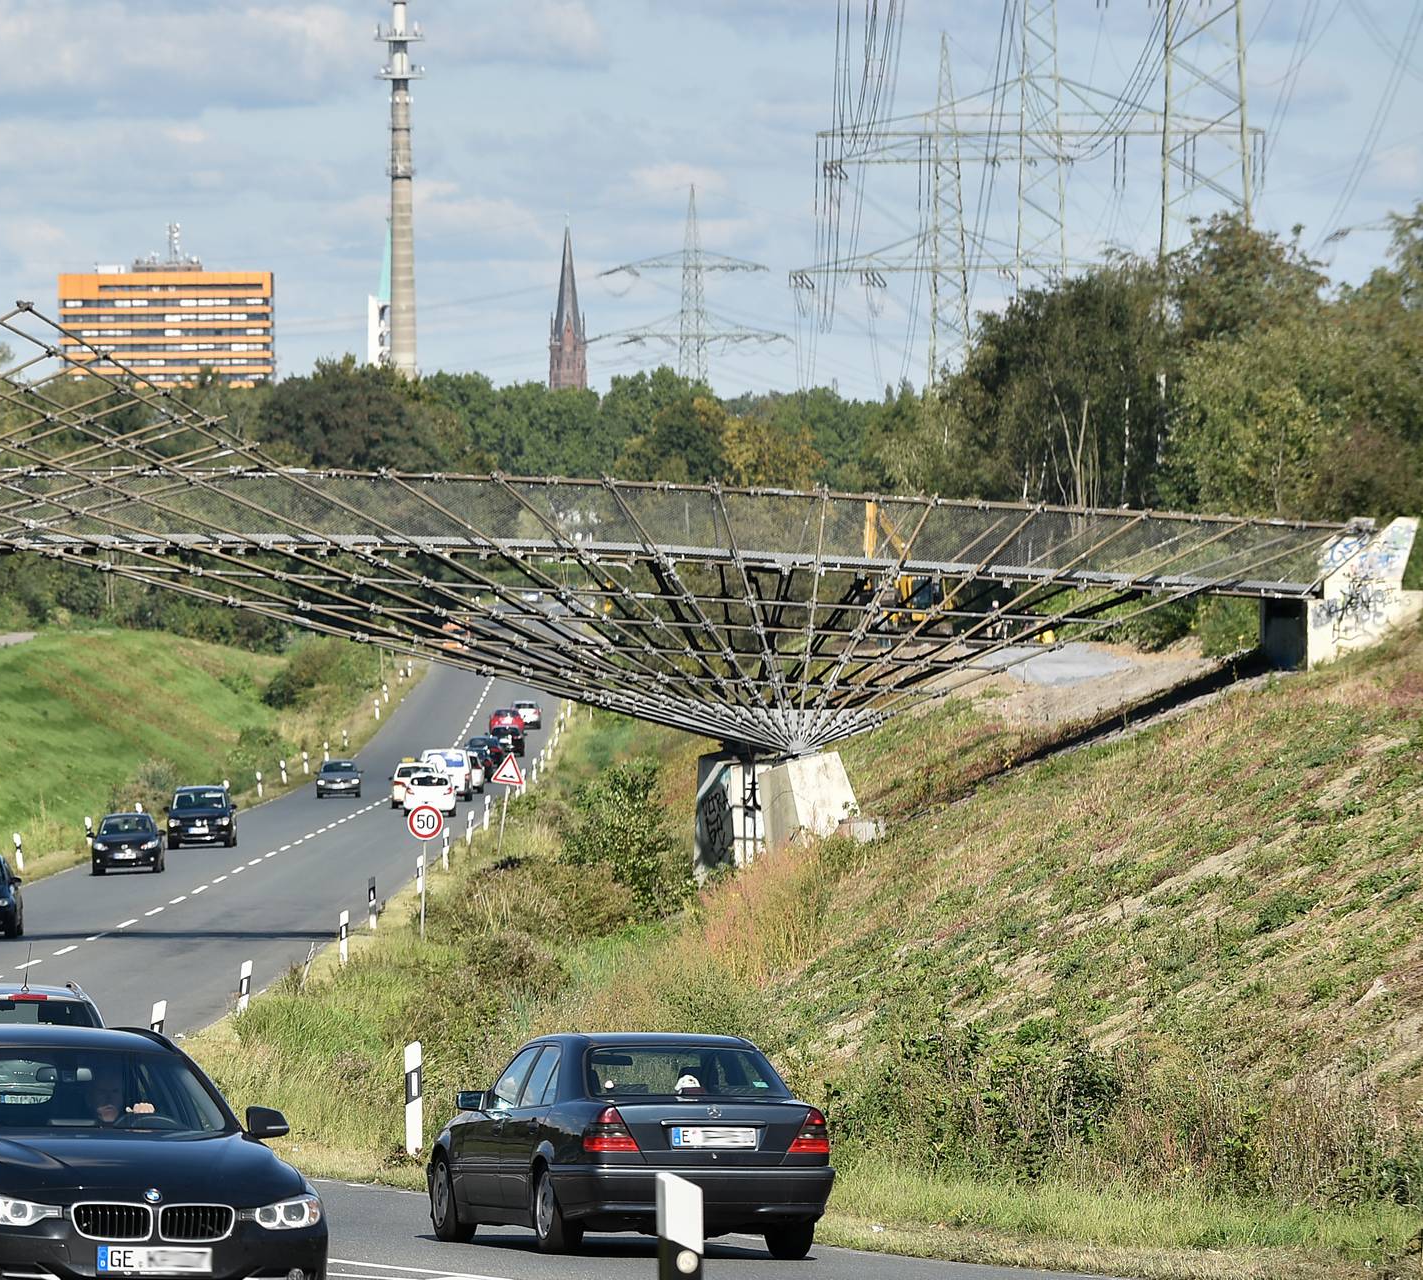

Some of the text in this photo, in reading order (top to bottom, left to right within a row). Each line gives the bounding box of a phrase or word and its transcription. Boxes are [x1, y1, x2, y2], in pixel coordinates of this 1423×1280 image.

[417, 814, 435, 829] 50
[682, 1130, 690, 1143] E
[110, 1250, 134, 1268] GE
